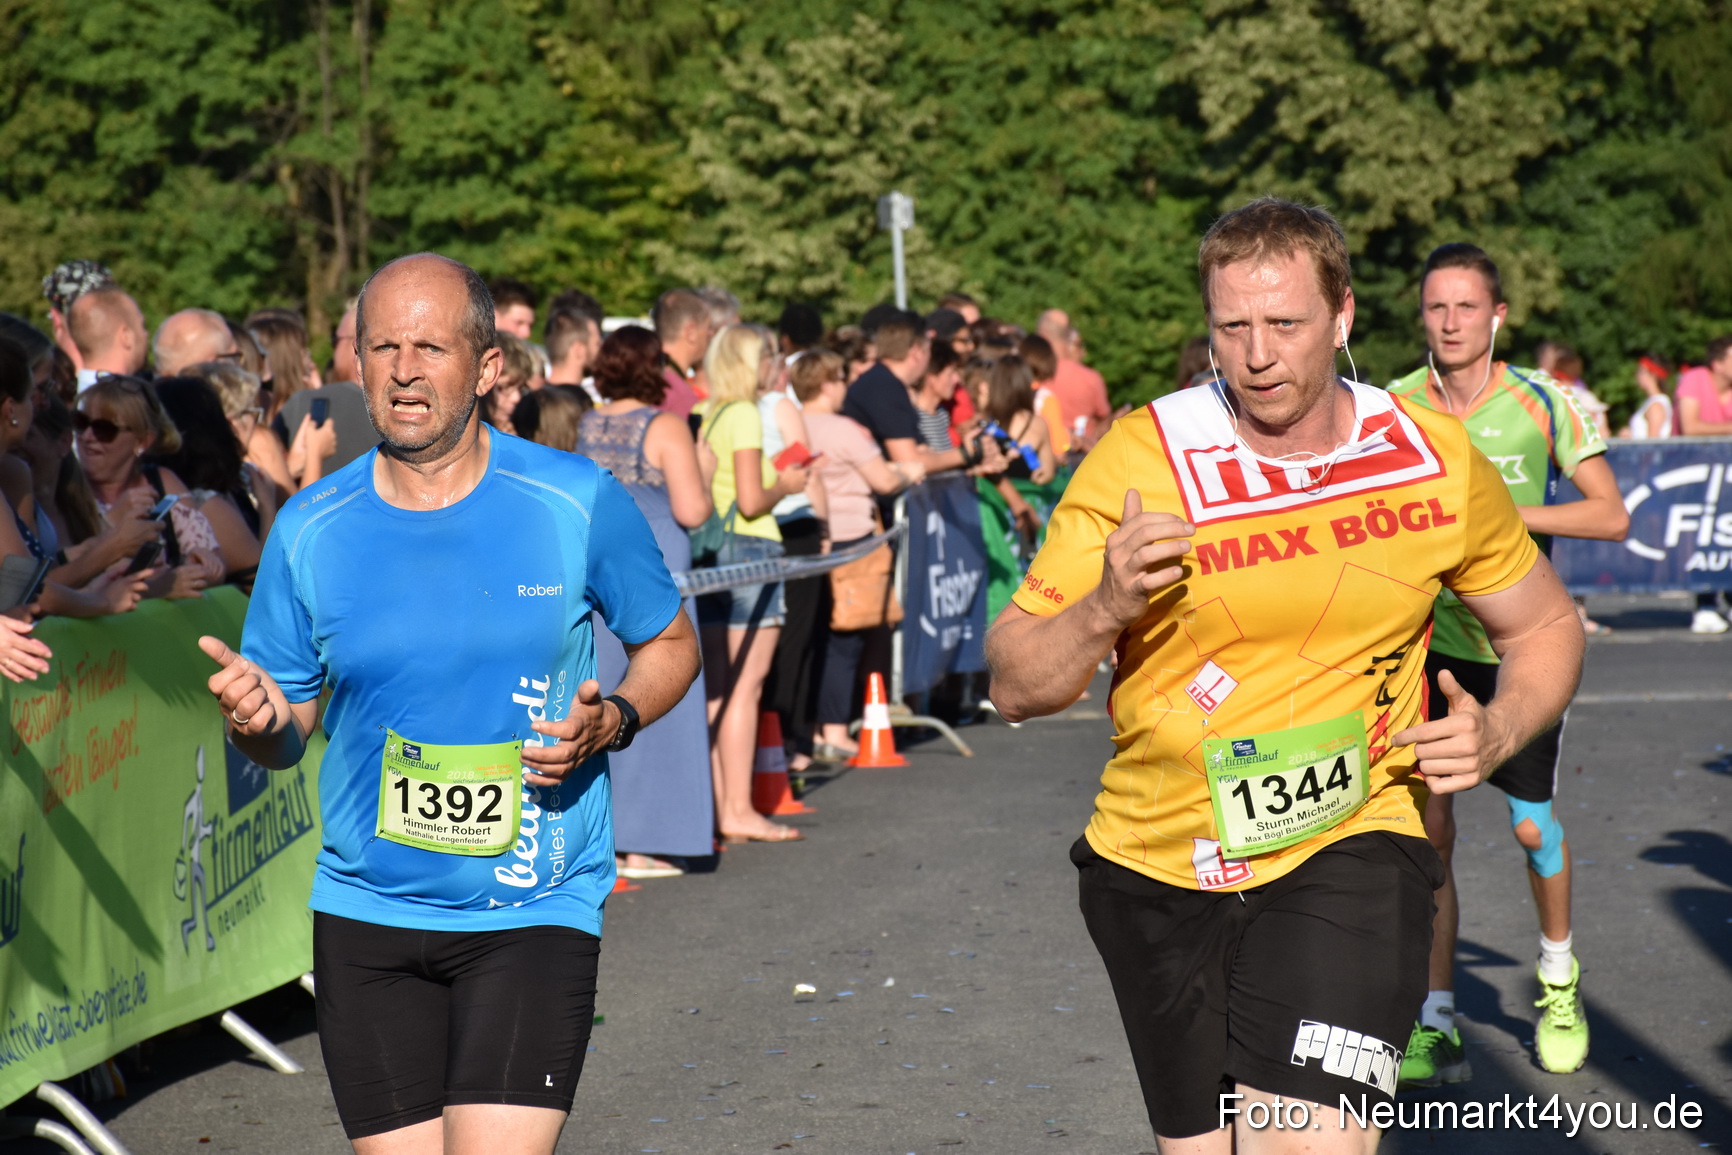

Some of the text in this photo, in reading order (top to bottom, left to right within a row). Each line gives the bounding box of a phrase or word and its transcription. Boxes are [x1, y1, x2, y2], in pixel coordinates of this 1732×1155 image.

[311, 487, 337, 504] JAKO
[1195, 497, 1457, 576] MAX BÖGL
[517, 583, 563, 597] Robert
[395, 752, 441, 771] firmenlauf
[1225, 749, 1279, 767] firmenlauf
[1288, 750, 1317, 766] 2018
[447, 770, 475, 780] 2018
[1232, 755, 1353, 820] 1344
[394, 776, 503, 824] 1392
[1245, 801, 1351, 844] Max Bögl Bauservice GmbH
[1256, 797, 1340, 832] Sturm Michael
[211, 763, 313, 899] firmenlauf
[403, 816, 491, 835] Himmler Robert
[405, 828, 435, 841] Nathalie
[436, 834, 488, 845] Lengenfelder
[218, 876, 266, 937] neumarkt
[545, 1074, 553, 1087] L
